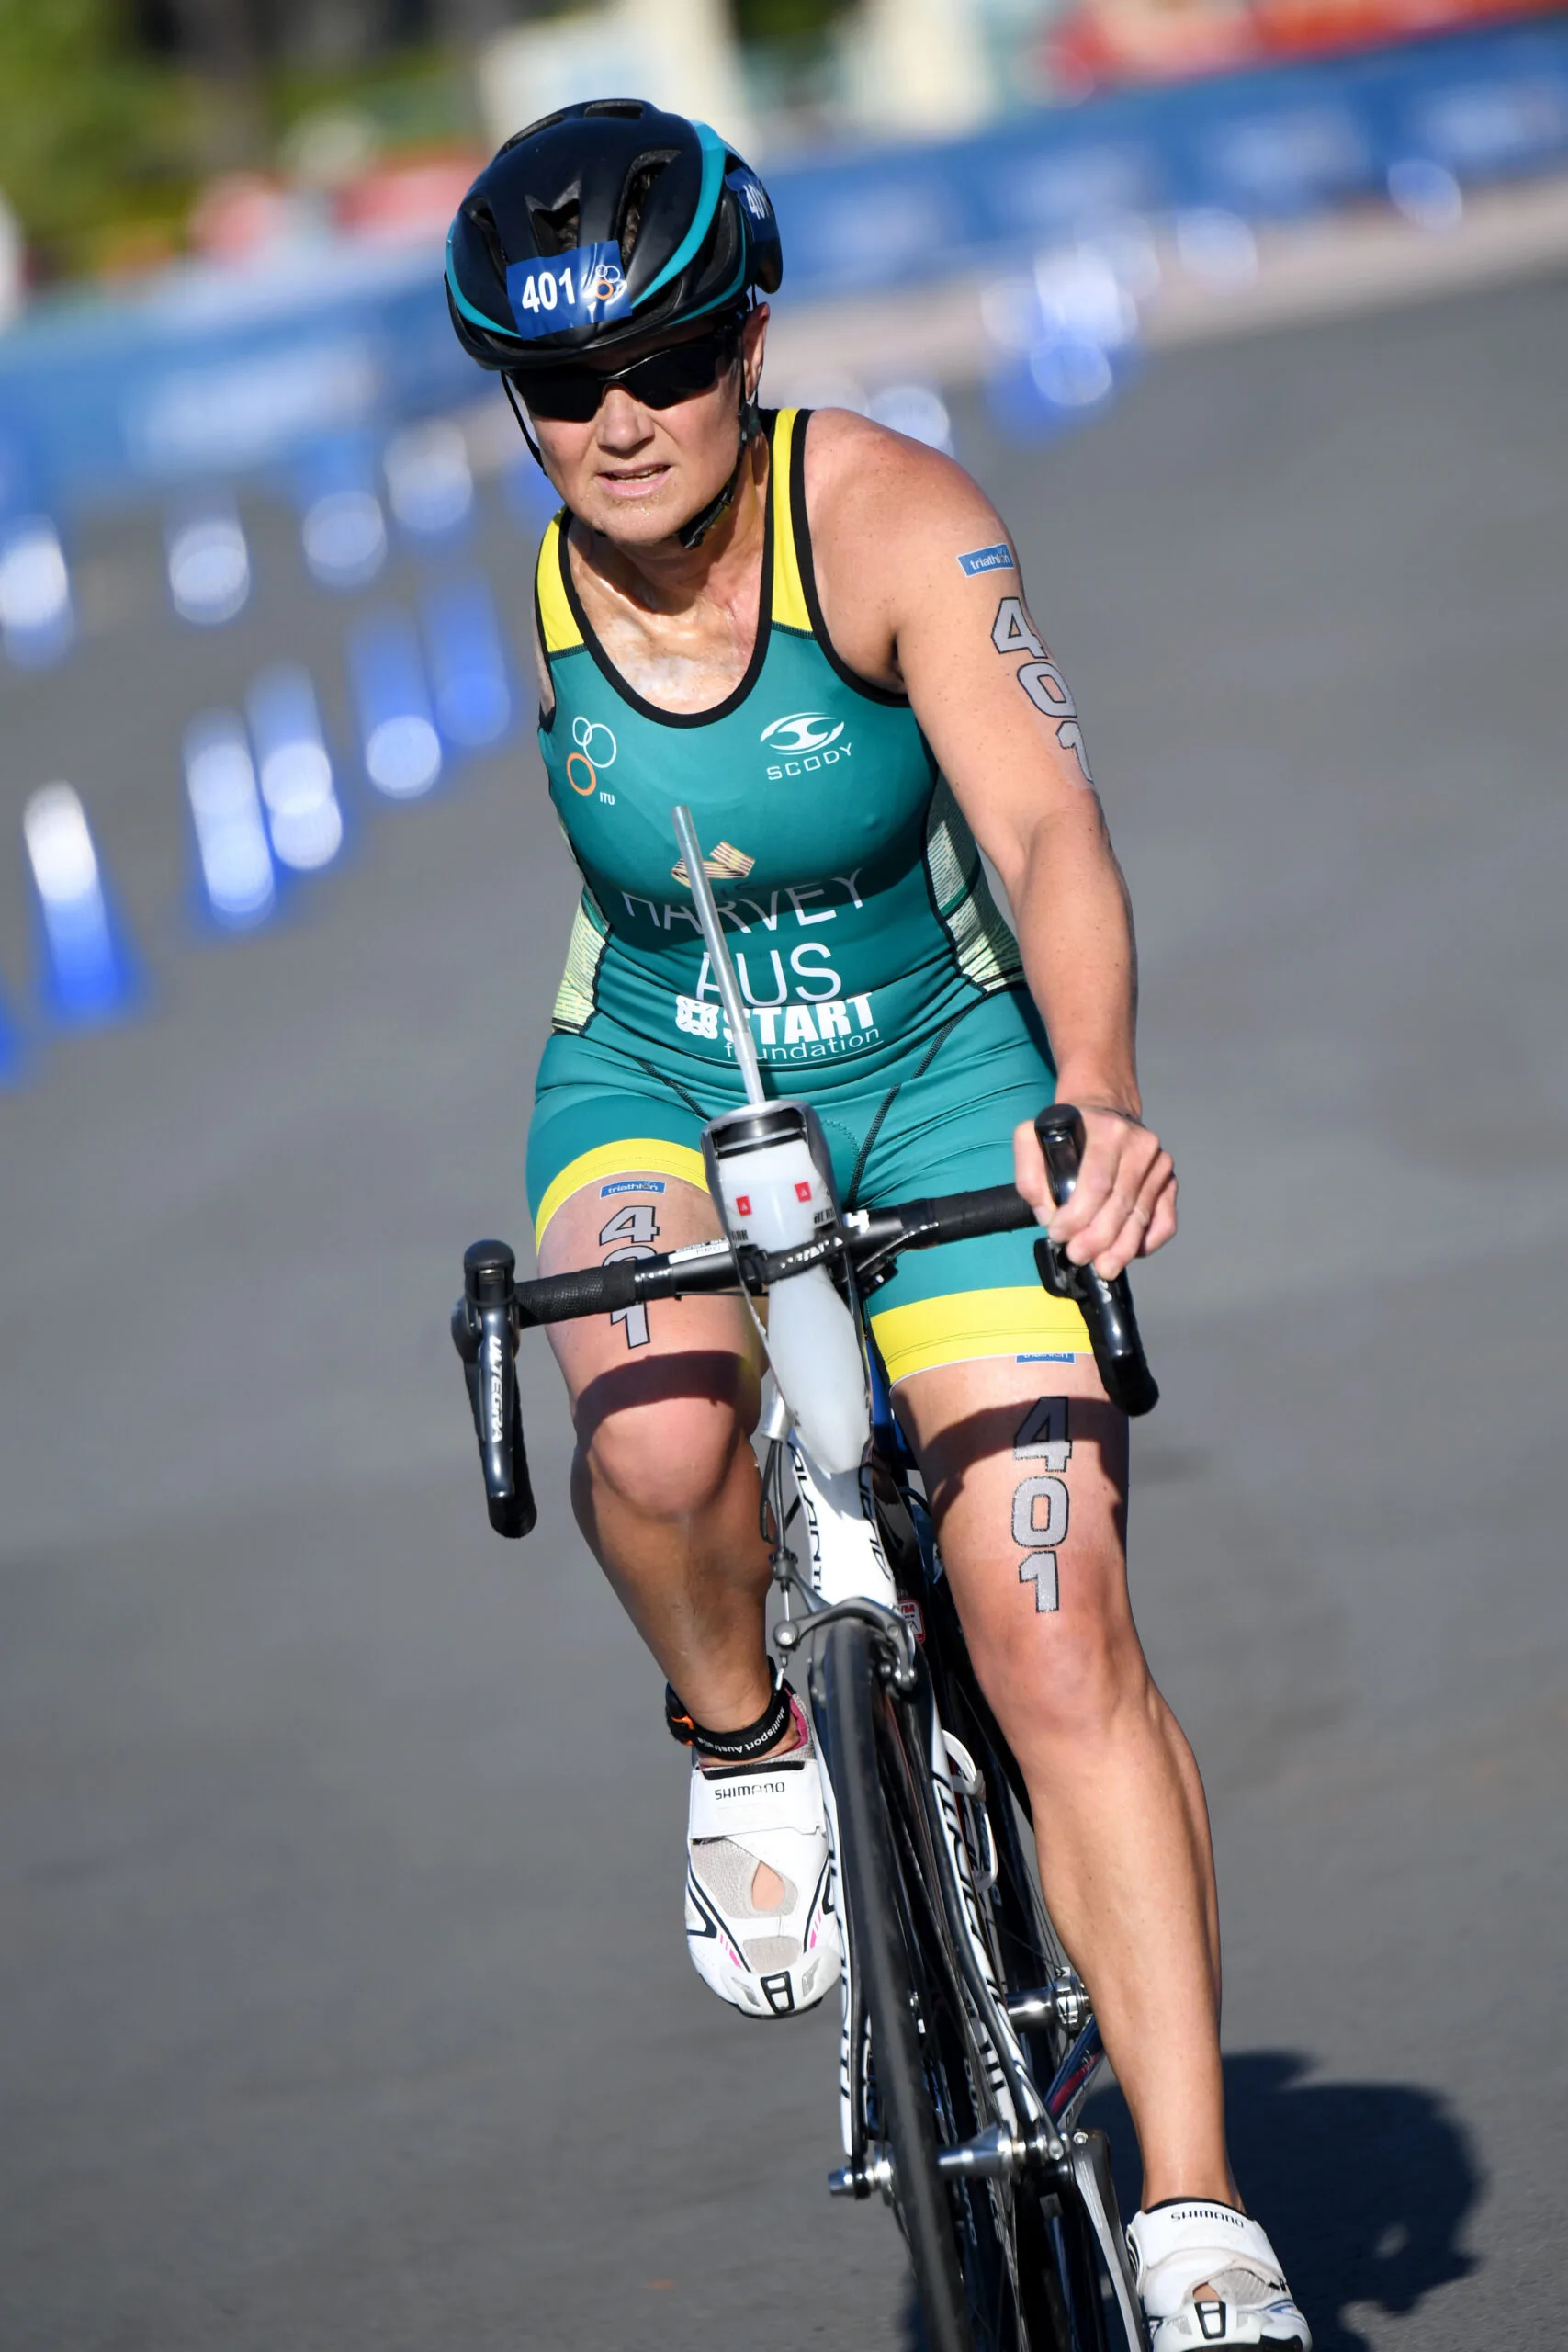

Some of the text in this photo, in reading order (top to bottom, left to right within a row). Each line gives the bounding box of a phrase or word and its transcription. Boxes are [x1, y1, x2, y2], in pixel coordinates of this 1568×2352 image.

[522, 267, 575, 313] 401
[970, 553, 1010, 570] triathlon
[991, 596, 1094, 784] 401
[766, 742, 852, 780] SCODY
[600, 791, 615, 806] ITU
[696, 942, 841, 1007] AUS
[608, 1182, 659, 1194] triathlon
[1011, 1396, 1073, 1613] 401
[715, 1781, 785, 1801] SHIMANO
[1170, 2210, 1245, 2228] SHIMANO
